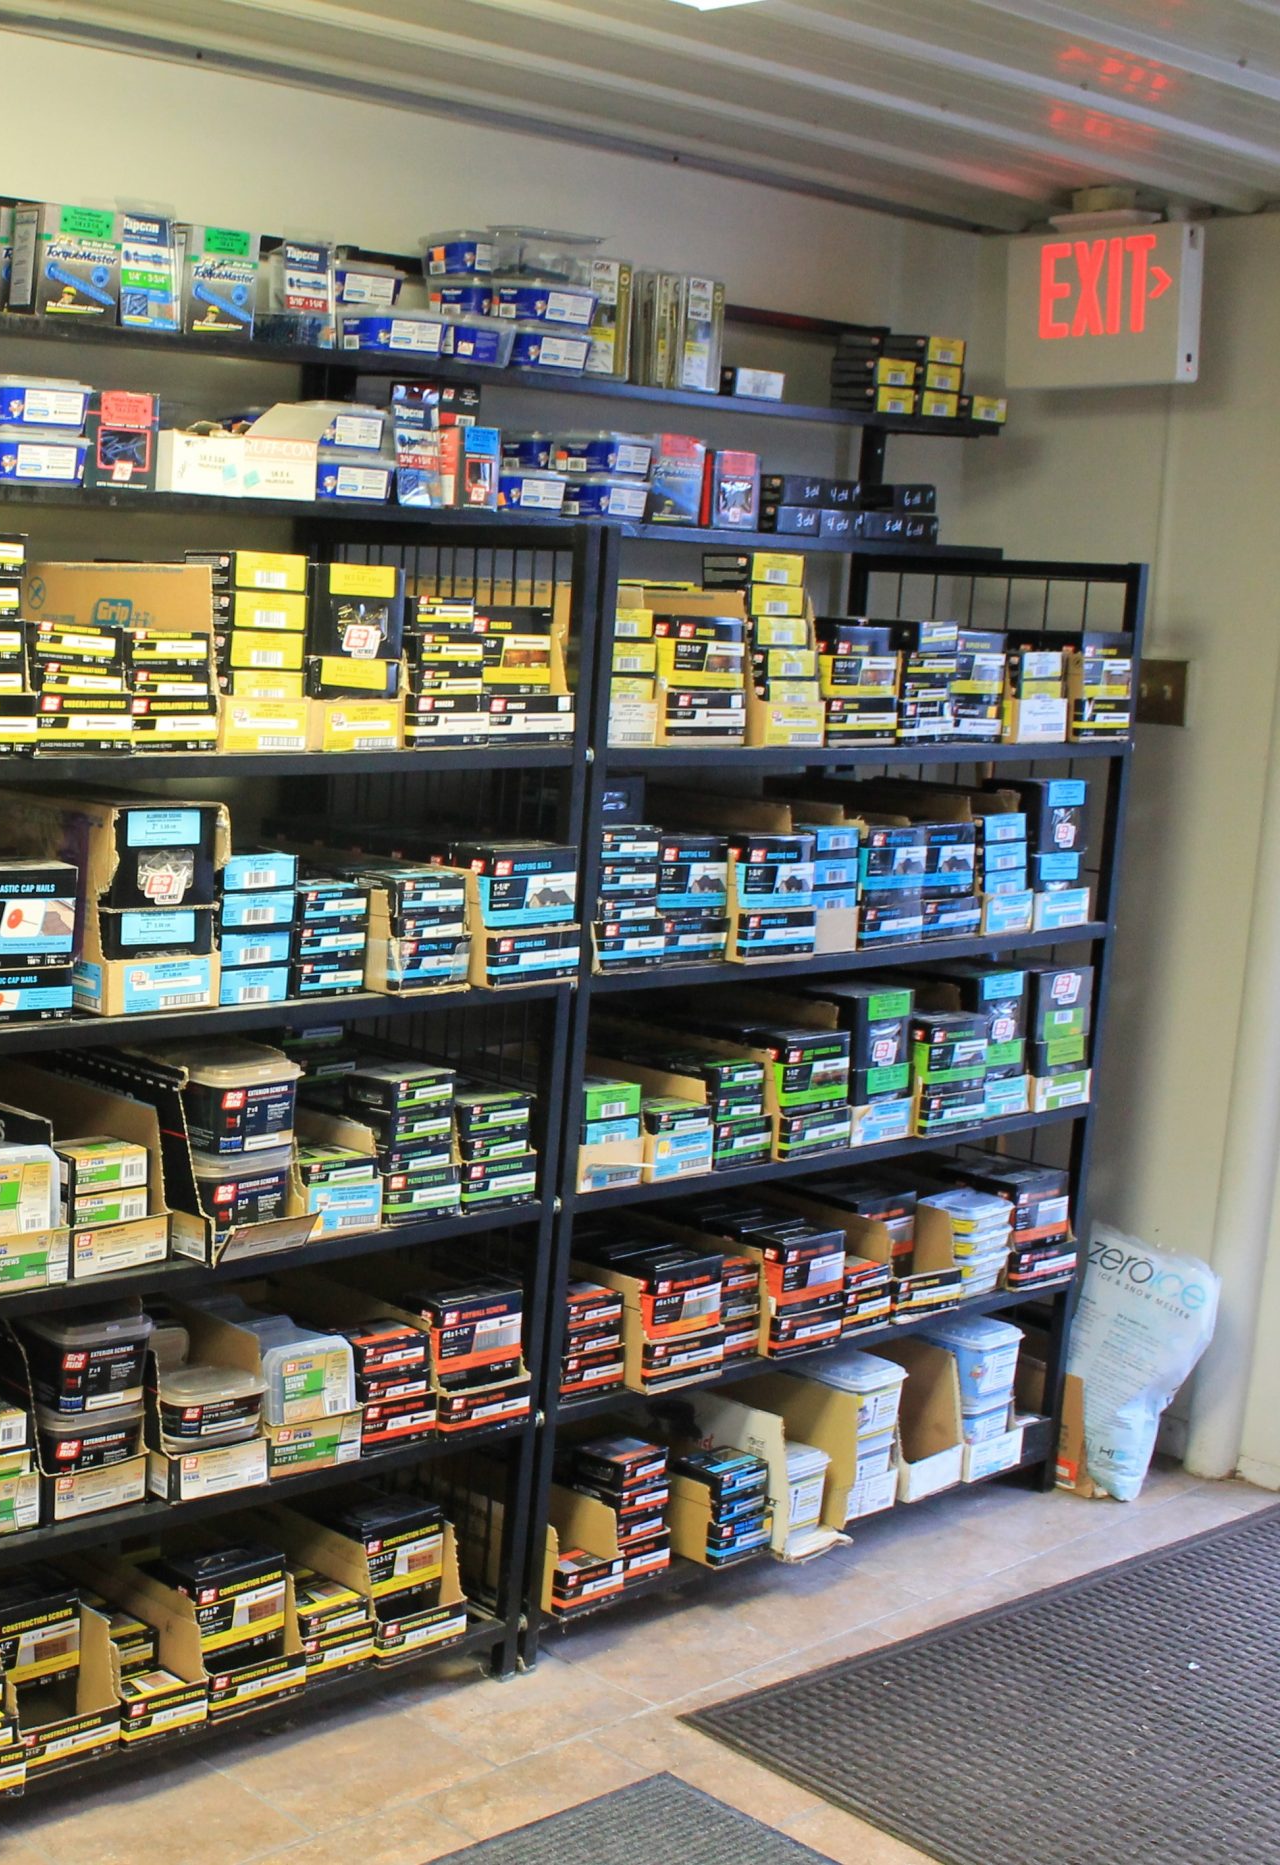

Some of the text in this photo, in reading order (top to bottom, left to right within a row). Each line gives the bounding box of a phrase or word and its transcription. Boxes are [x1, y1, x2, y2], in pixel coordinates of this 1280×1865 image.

[286, 246, 320, 263] Tapcon
[1038, 234, 1156, 339] EXIT
[394, 404, 424, 421] Tapcon
[96, 602, 129, 624] Grip
[63, 700, 126, 709] UNDERLAYMENT NAILS
[193, 702, 209, 710] NAILS
[537, 862, 552, 870] NAILS
[21, 885, 34, 893] CAP
[36, 884, 55, 892] NAILS
[227, 1092, 243, 1100] Grip
[248, 1085, 288, 1097] EXTERIOR SCREWS
[260, 1177, 279, 1185] SCREWS
[1098, 1271, 1112, 1283] ICE
[1123, 1283, 1151, 1301] SNOW
[1156, 1298, 1190, 1320] MELTER
[67, 1354, 86, 1362] Grip
[90, 1345, 134, 1358] EXTERIOR SCREWS
[83, 1432, 125, 1446] EXTERIOR SCREWS
[293, 1431, 312, 1440] PLUS
[60, 1441, 79, 1450] Grip
[58, 1449, 76, 1457] Rite
[383, 1523, 439, 1548] CONSTRUCTION SCREWS
[219, 1570, 282, 1597] CONSTRUCTION SCREWS
[1, 1608, 73, 1634] CONSTRUCTION SCREWS
[231, 1661, 288, 1684] CONSTRUCTION SCREWS
[148, 1689, 205, 1710] CONSTRUCTION SCREWS
[39, 1717, 101, 1742] CONSTRUCTION SCREWS
